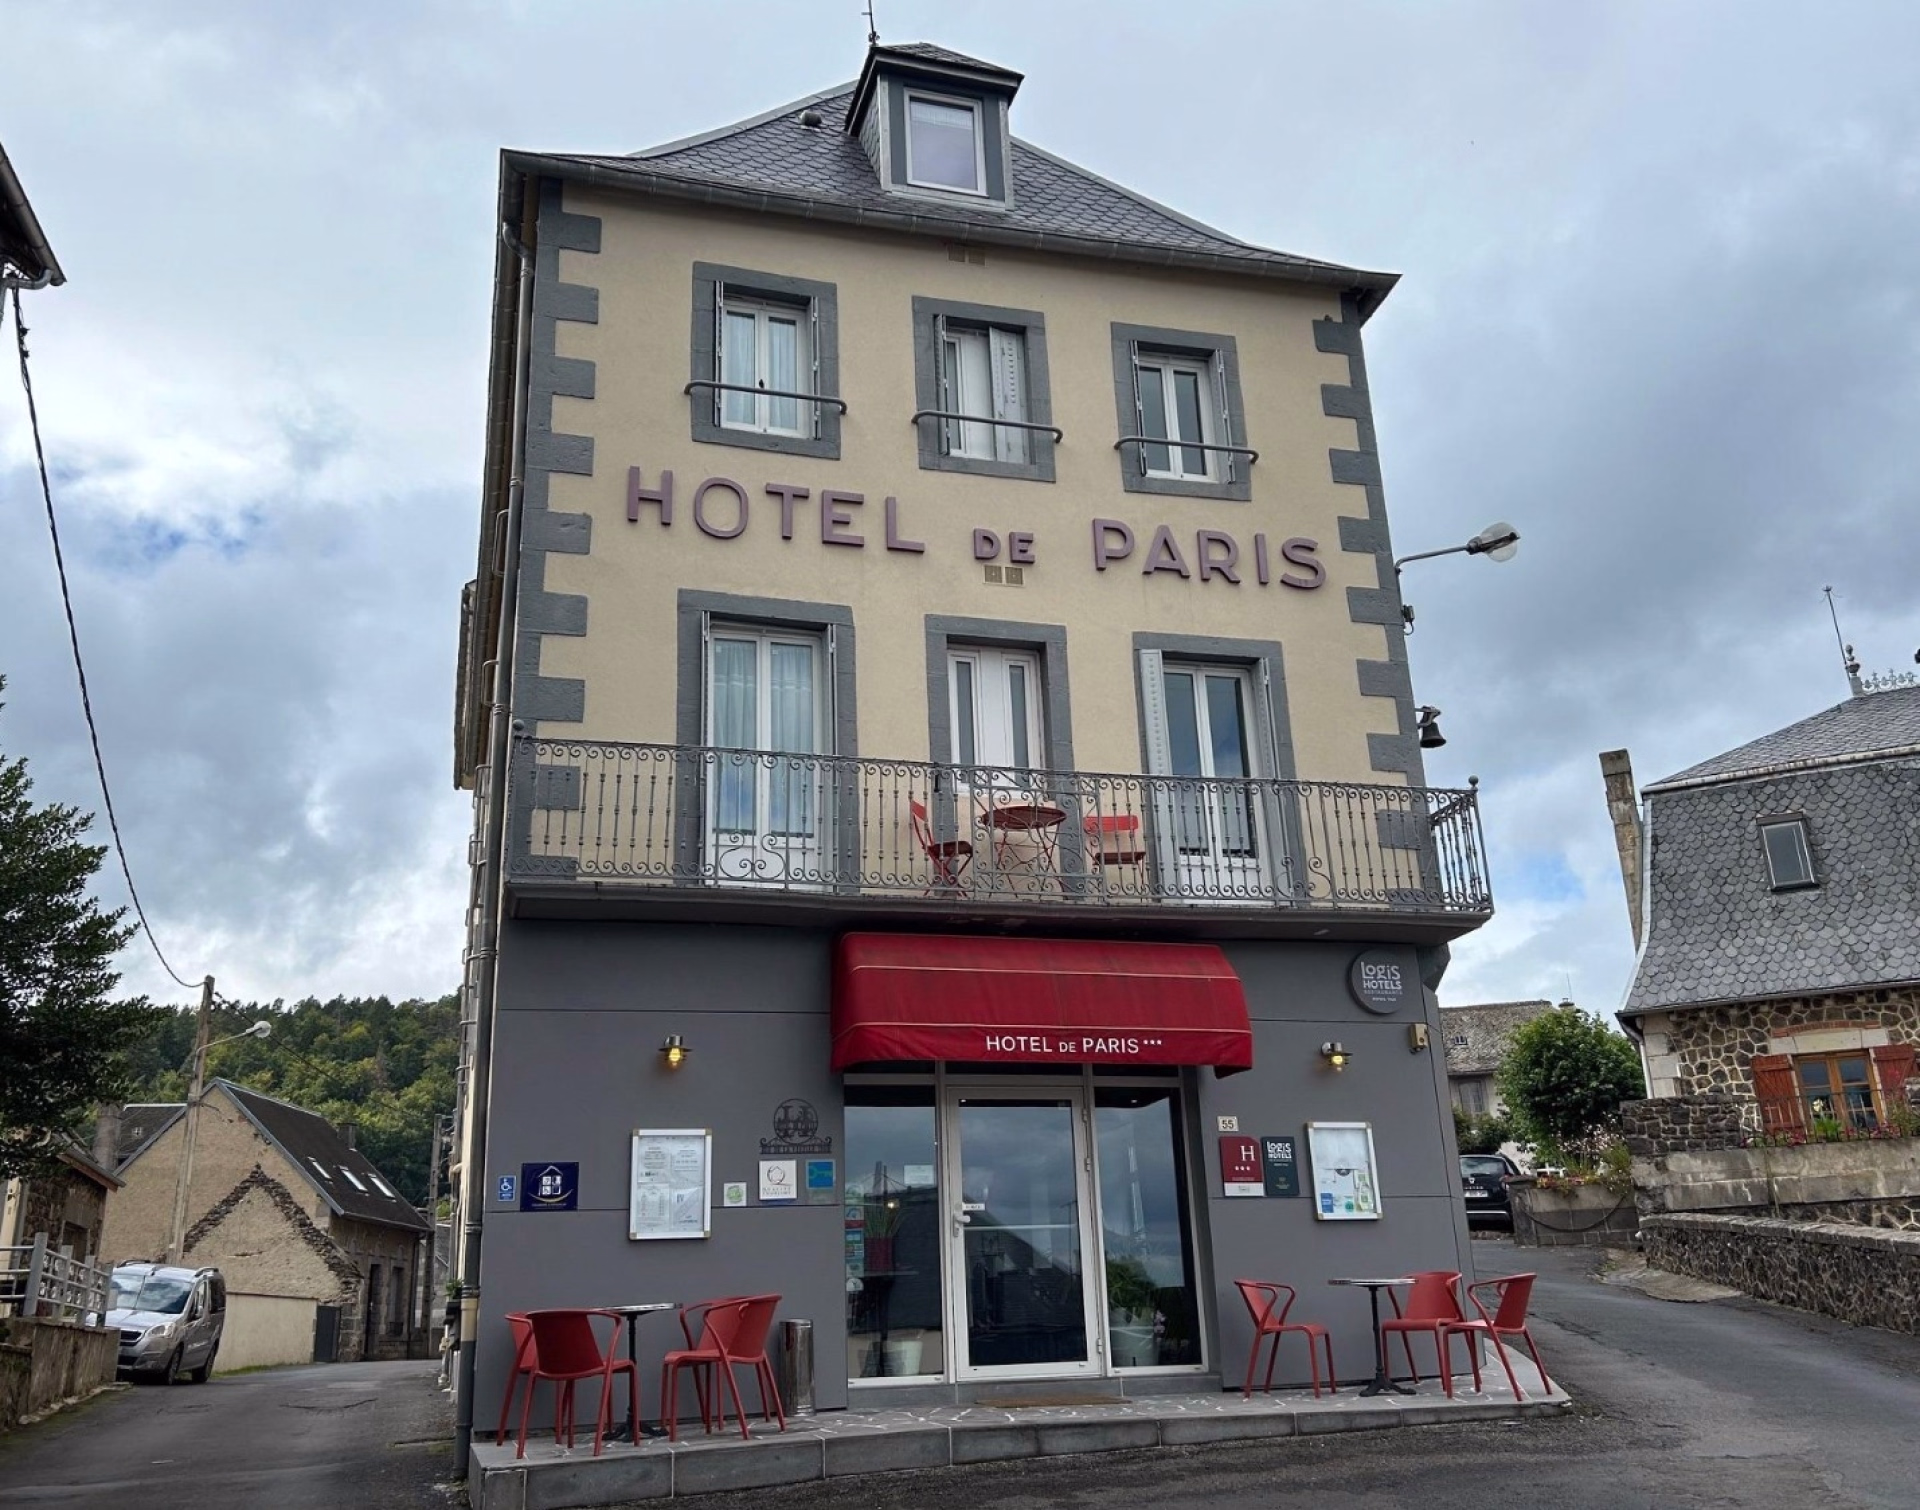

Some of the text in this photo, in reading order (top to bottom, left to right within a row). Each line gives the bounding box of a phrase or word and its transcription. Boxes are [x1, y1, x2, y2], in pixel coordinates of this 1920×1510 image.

[627, 465, 1327, 589] HOTEL DE PARIS
[986, 1035, 1139, 1054] HOTEL DE PARIS
[1222, 1119, 1234, 1129] 55
[1240, 1145, 1256, 1161] H
